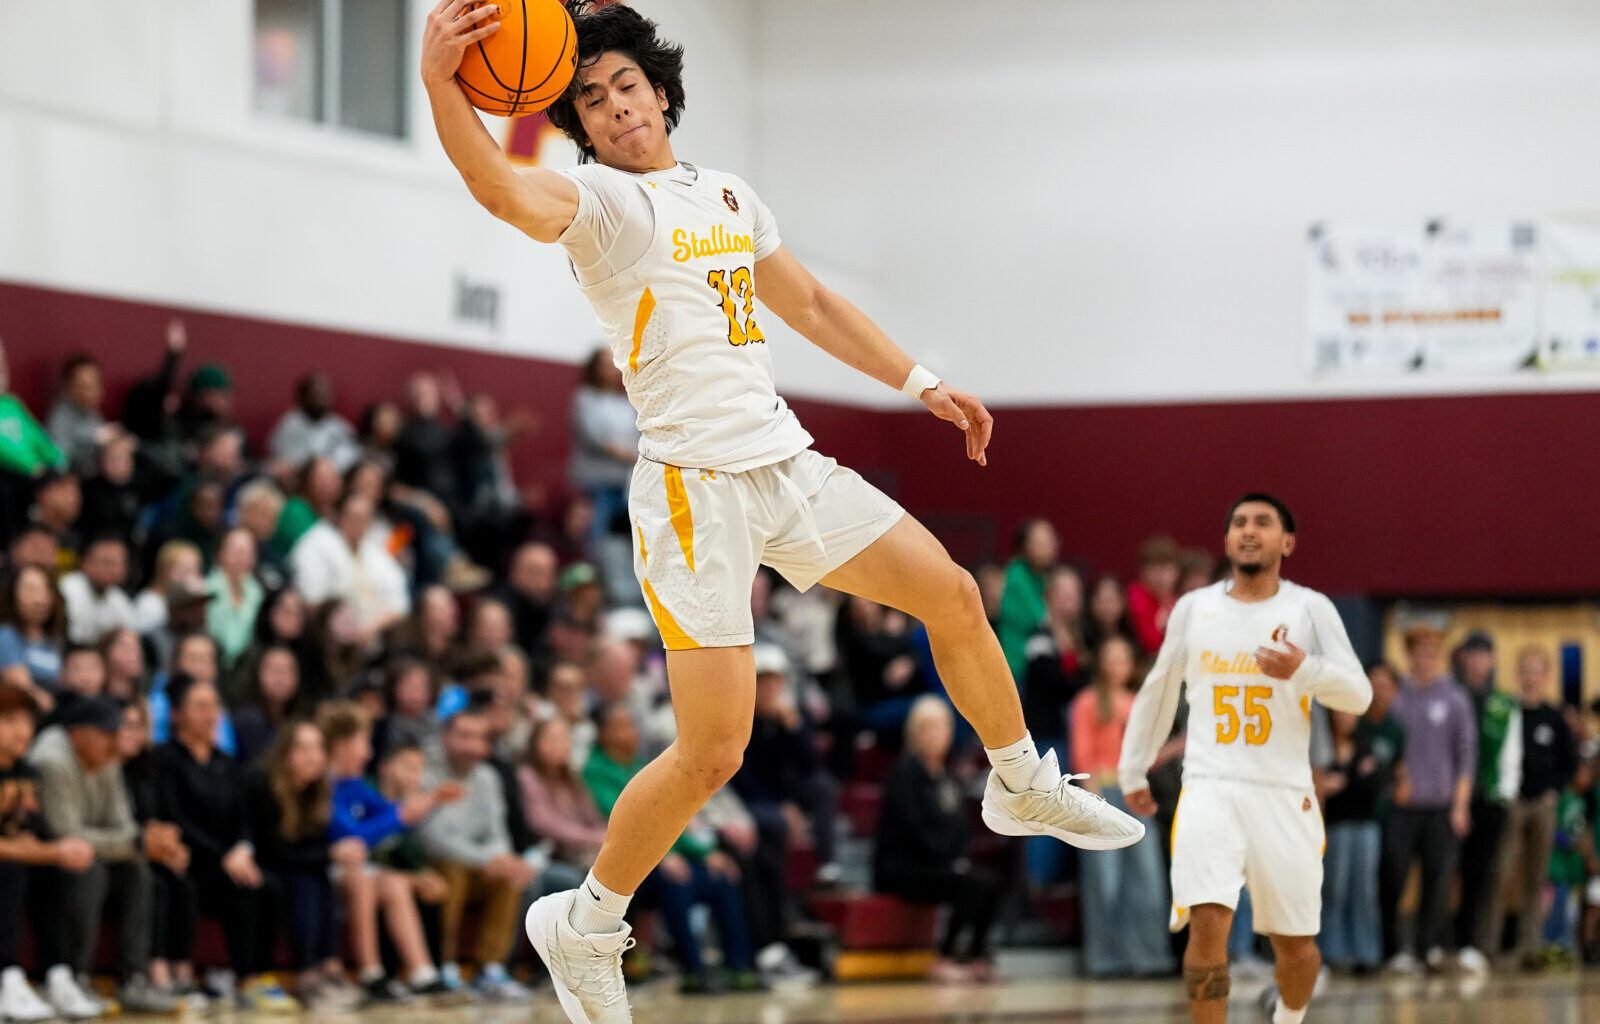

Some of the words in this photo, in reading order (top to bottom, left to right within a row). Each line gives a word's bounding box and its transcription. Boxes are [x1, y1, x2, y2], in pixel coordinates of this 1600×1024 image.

[672, 224, 755, 262] Stallion
[708, 266, 765, 346] 12
[1213, 685, 1273, 746] 55
